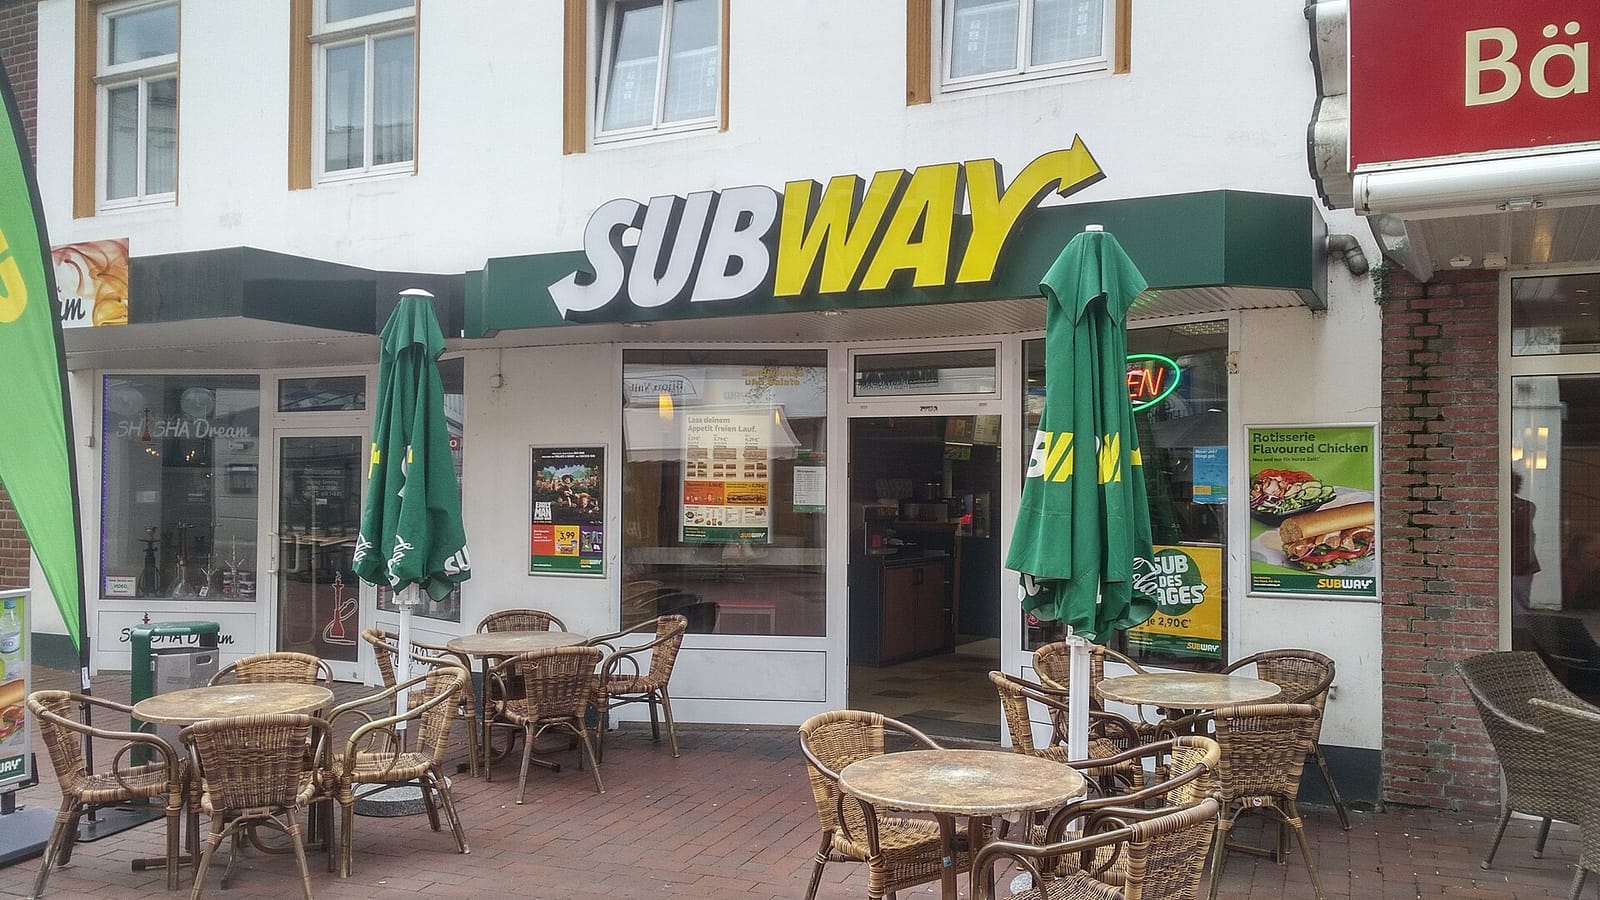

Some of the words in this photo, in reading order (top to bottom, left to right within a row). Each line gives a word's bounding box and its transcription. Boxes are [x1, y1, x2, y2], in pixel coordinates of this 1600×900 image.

[1465, 21, 1589, 107] Bä
[548, 133, 1106, 319] SUBWAY
[1127, 367, 1165, 397] EN
[704, 416, 731, 424] deinem
[193, 418, 251, 440] Dream
[688, 425, 713, 433] Appetit
[1253, 432, 1316, 443] Rotisserie
[1253, 444, 1315, 454] Flavoured
[1318, 443, 1369, 453] Chicken
[534, 507, 552, 518] MAN
[560, 531, 575, 540] 3,99
[1159, 575, 1183, 588] DES
[1317, 578, 1374, 590] SUBWAY
[1157, 585, 1208, 606] AGES
[1146, 617, 1156, 627] je
[1186, 641, 1219, 653] SUBWAY
